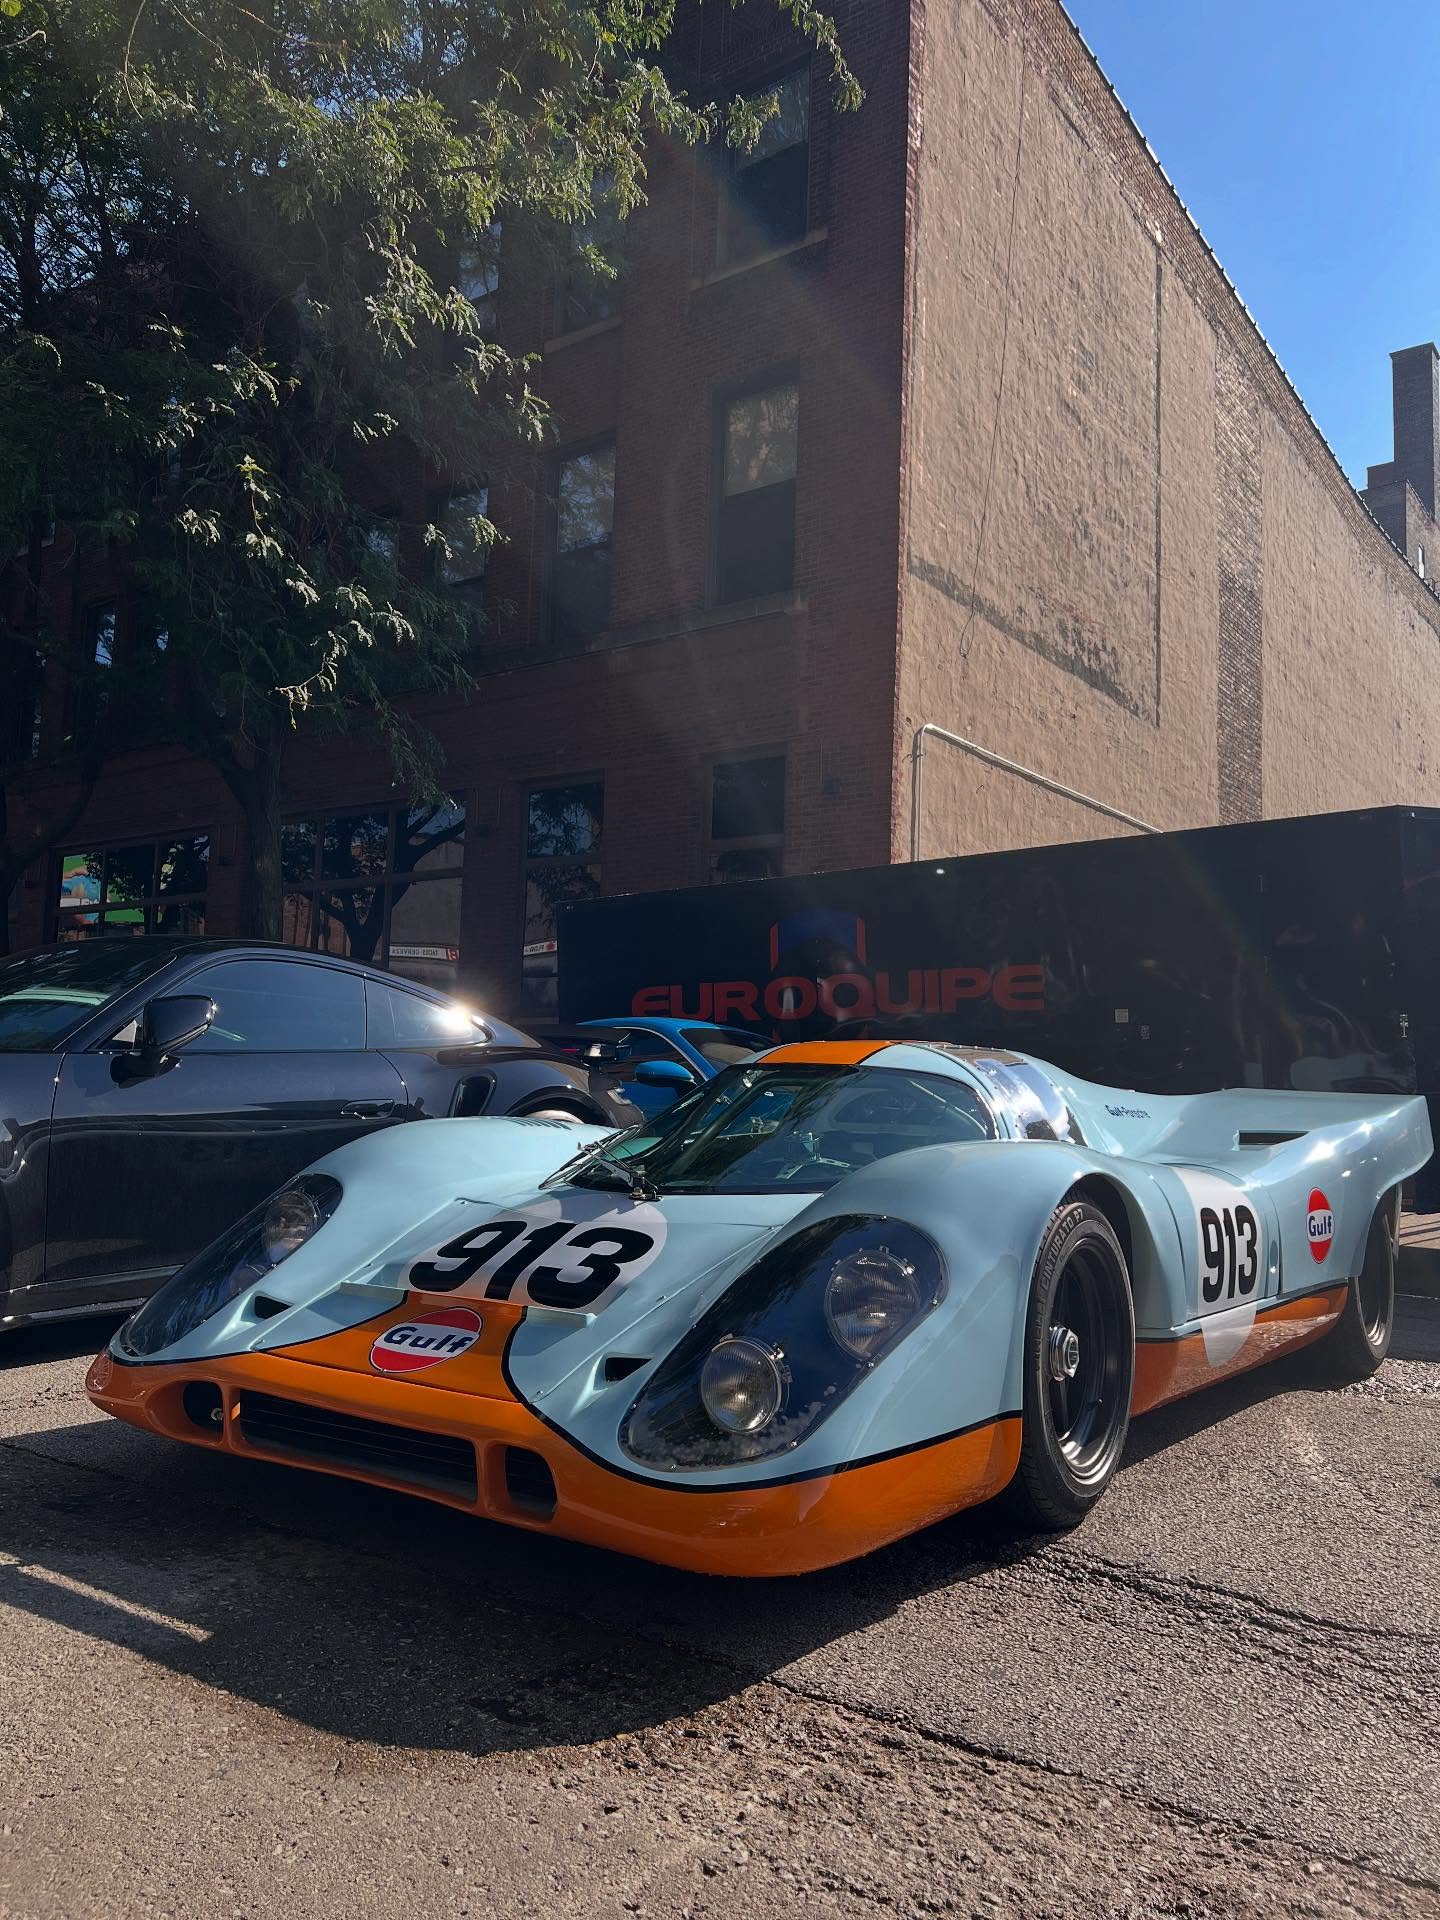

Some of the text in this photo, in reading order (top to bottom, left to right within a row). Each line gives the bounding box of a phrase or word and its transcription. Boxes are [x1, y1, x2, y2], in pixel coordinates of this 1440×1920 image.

[631, 964, 1045, 1021] EUROQUIPE
[1042, 1208, 1084, 1292] CINTURATO P7
[1200, 1205, 1258, 1303] 913
[1308, 1215, 1332, 1237] Gulf
[408, 1220, 655, 1309] 913
[383, 1325, 474, 1354] Gulf
